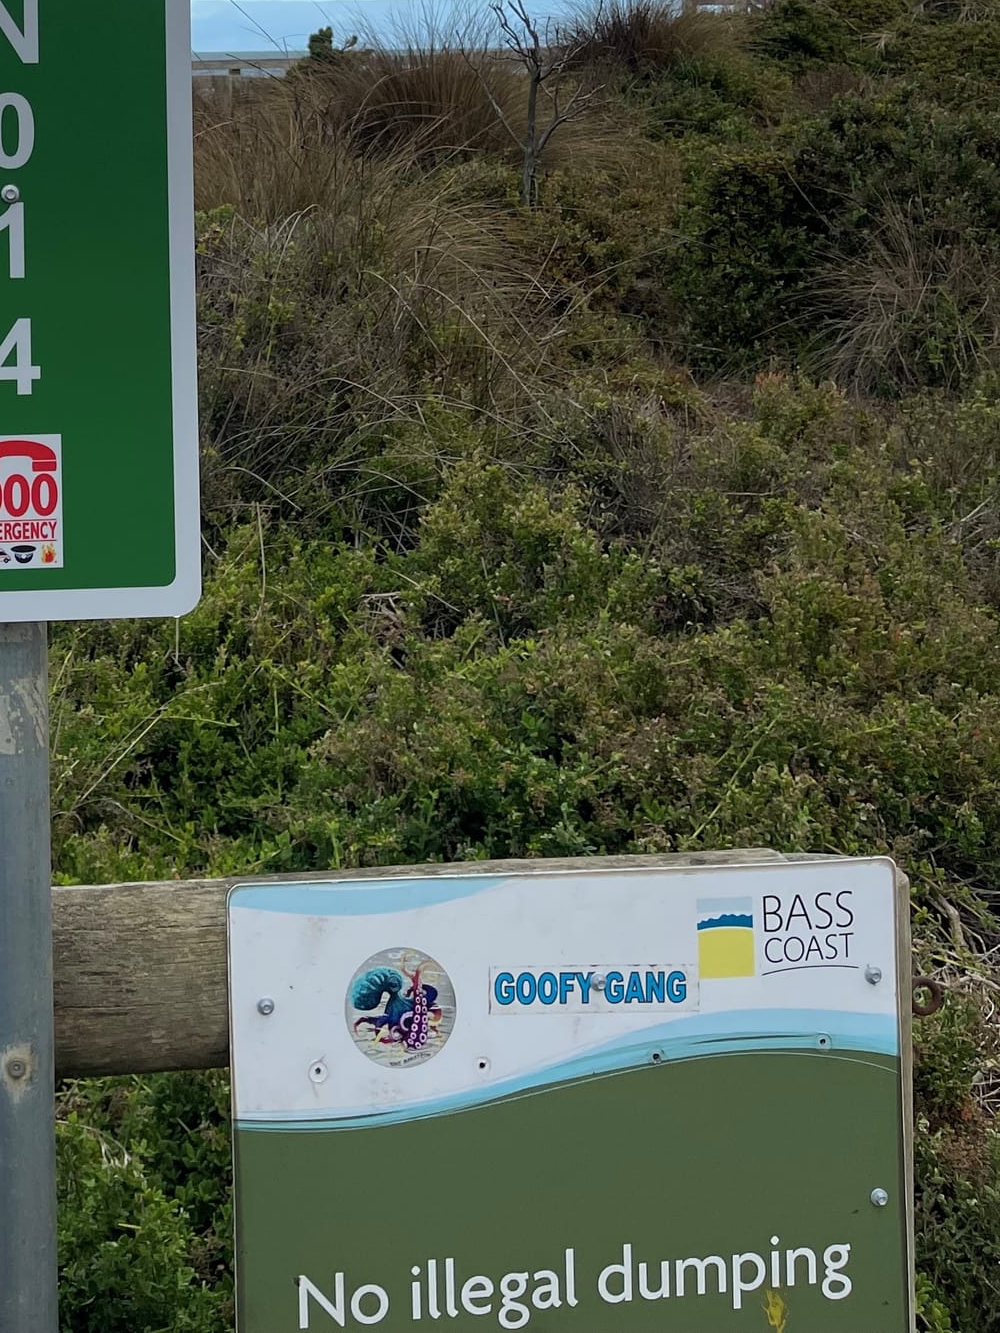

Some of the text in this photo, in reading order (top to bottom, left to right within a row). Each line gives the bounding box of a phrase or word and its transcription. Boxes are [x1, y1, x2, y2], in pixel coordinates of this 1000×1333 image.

[762, 890, 854, 932] BASS
[764, 932, 854, 963] COAST
[494, 970, 687, 1006] GOOFY GANG
[298, 1235, 852, 1329] No illegal dumping
